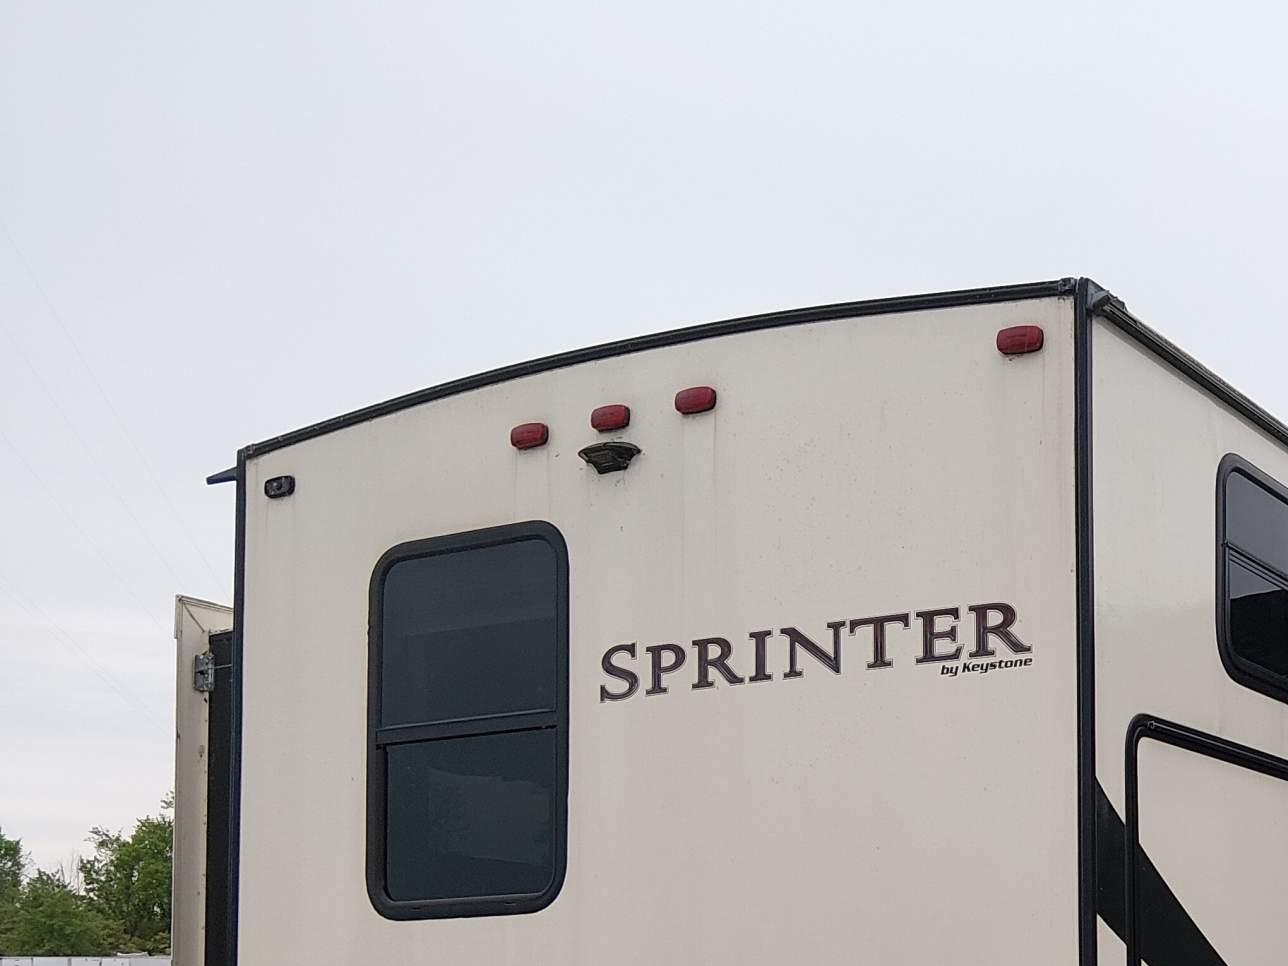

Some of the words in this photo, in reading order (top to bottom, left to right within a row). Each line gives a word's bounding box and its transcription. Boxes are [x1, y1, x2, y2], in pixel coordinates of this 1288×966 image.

[599, 601, 1033, 703] SPRINTER
[940, 663, 959, 678] by
[961, 656, 1033, 675] Keystone
